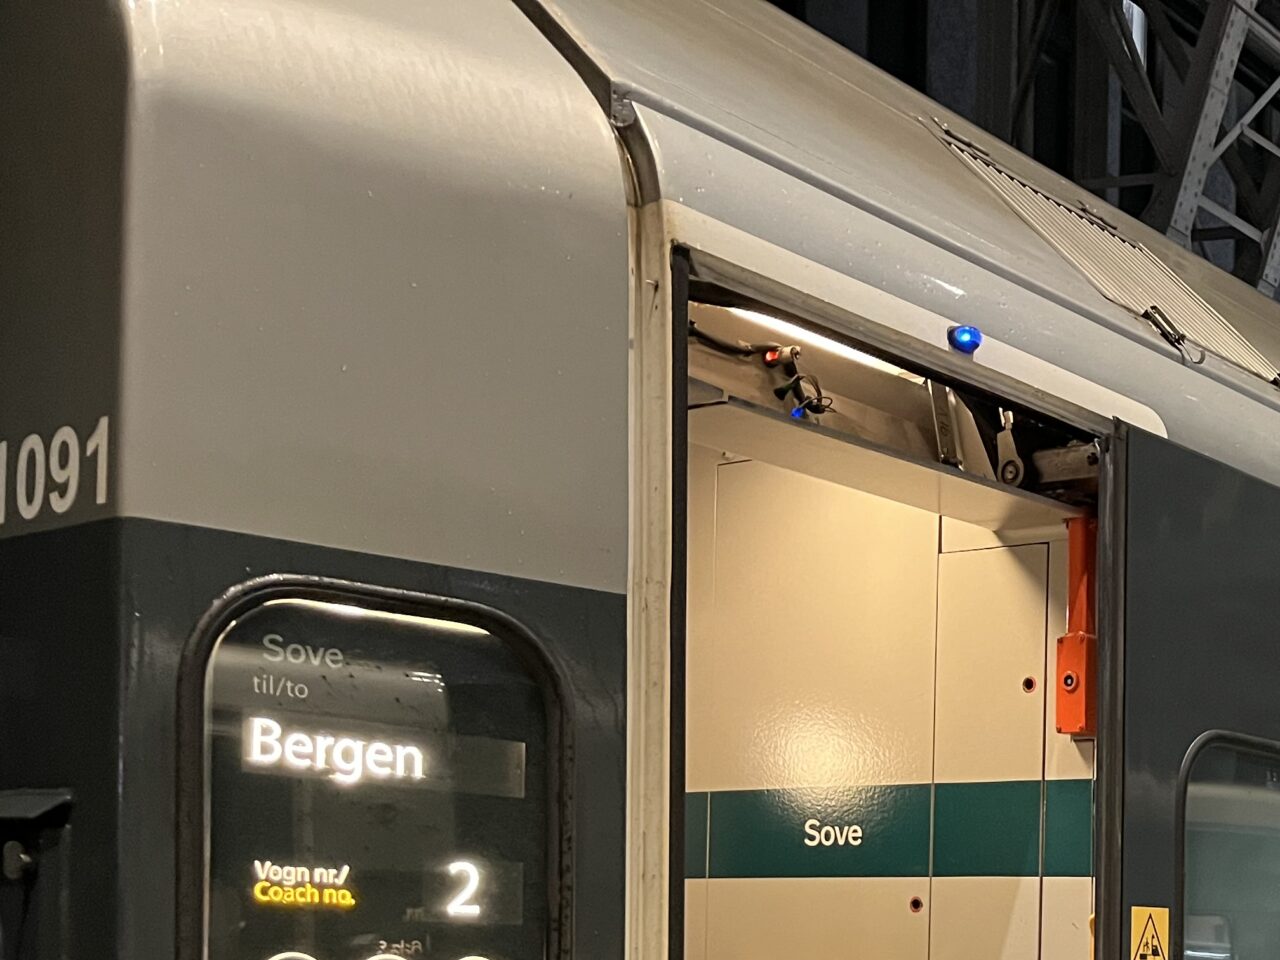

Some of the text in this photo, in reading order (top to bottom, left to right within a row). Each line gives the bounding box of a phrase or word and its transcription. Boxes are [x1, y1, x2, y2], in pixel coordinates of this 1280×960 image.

[262, 633, 344, 668] Sove
[253, 675, 309, 698] til/to
[248, 716, 425, 783] Bergen
[804, 818, 863, 847] Sove
[254, 860, 310, 886] Vogn
[254, 881, 356, 906] Coach no.
[446, 860, 481, 917] 2
